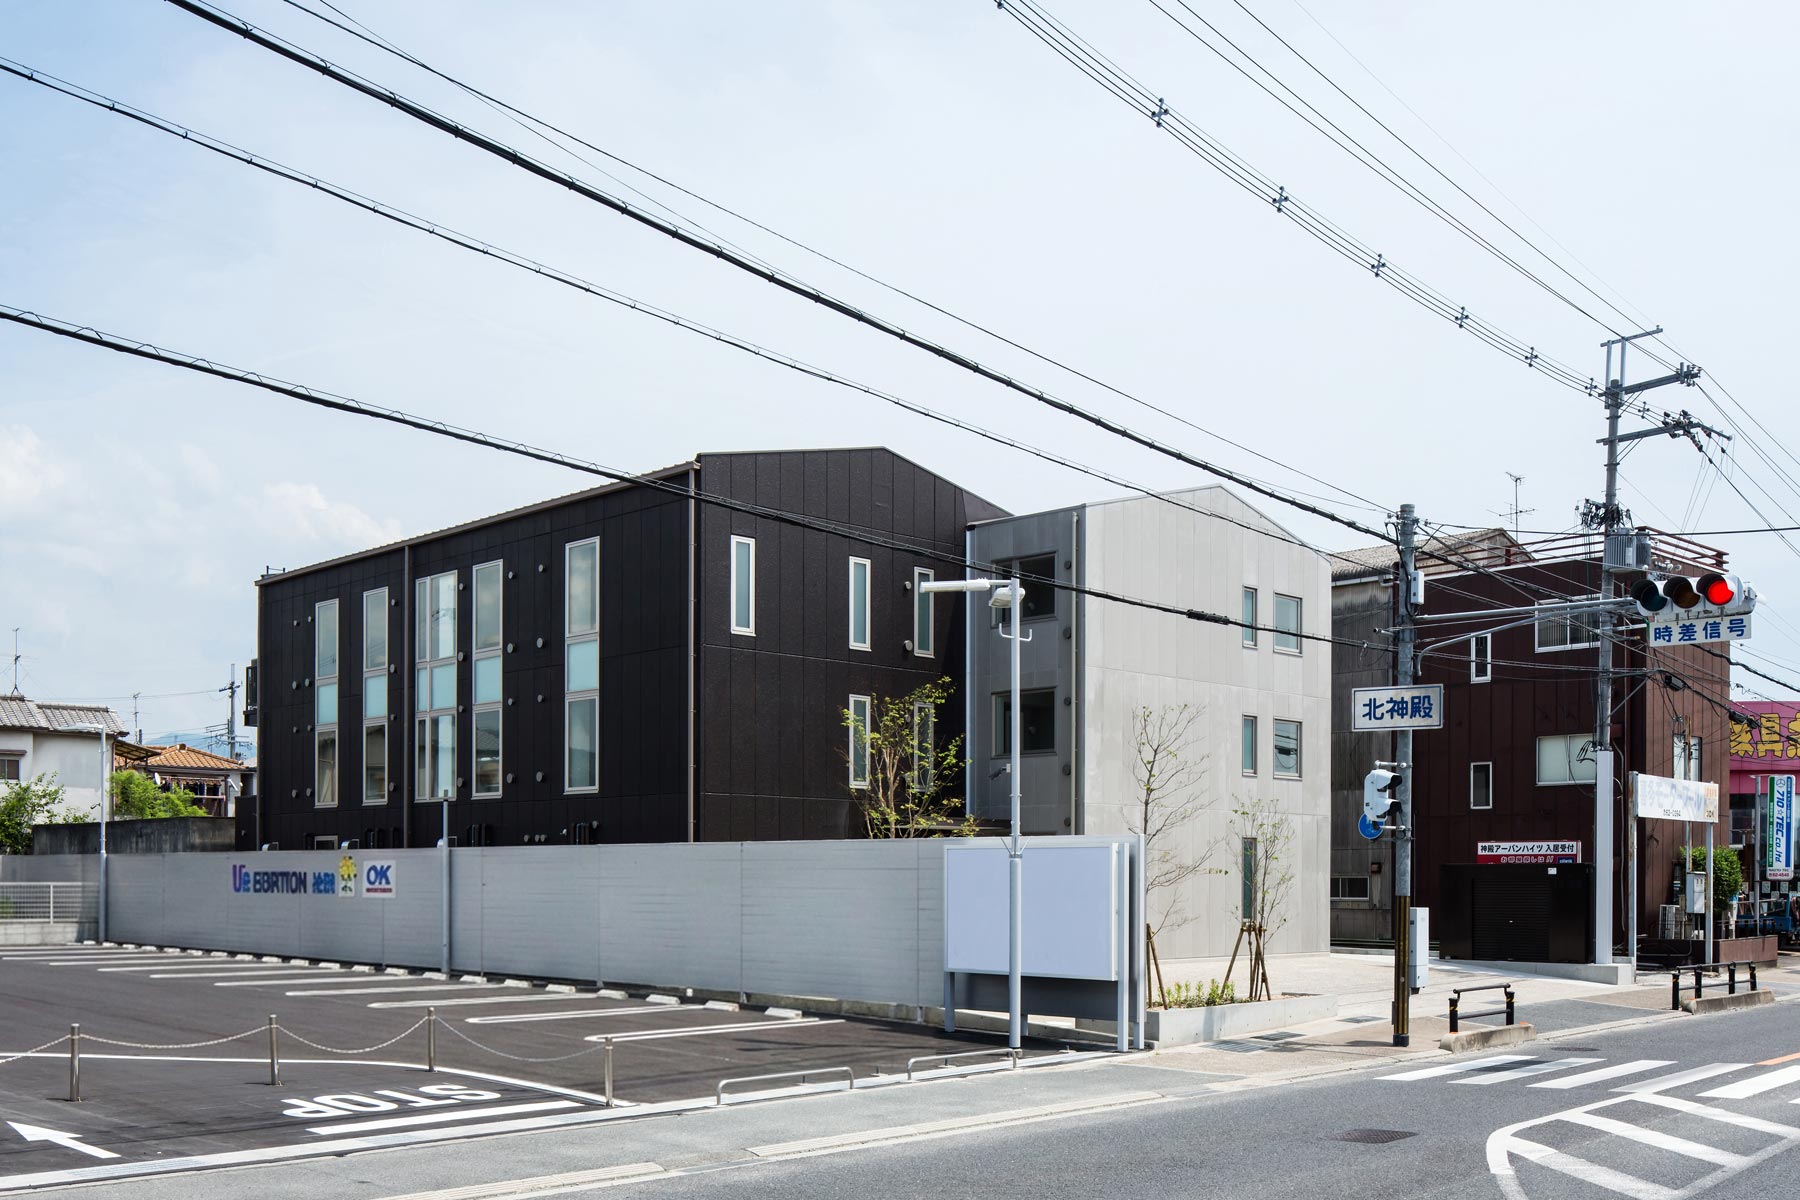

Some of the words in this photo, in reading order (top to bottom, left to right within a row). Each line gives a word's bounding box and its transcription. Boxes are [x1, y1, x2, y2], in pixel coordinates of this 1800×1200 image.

[1653, 617, 1747, 643] 時差信号
[1362, 695, 1434, 721] 北神殿
[1775, 815, 1784, 838] TEC
[1480, 844, 1543, 853] 神殿アーバンハイツ
[1545, 843, 1575, 853] 入居受付
[366, 864, 392, 886] OK
[281, 1084, 501, 1118] STOP
